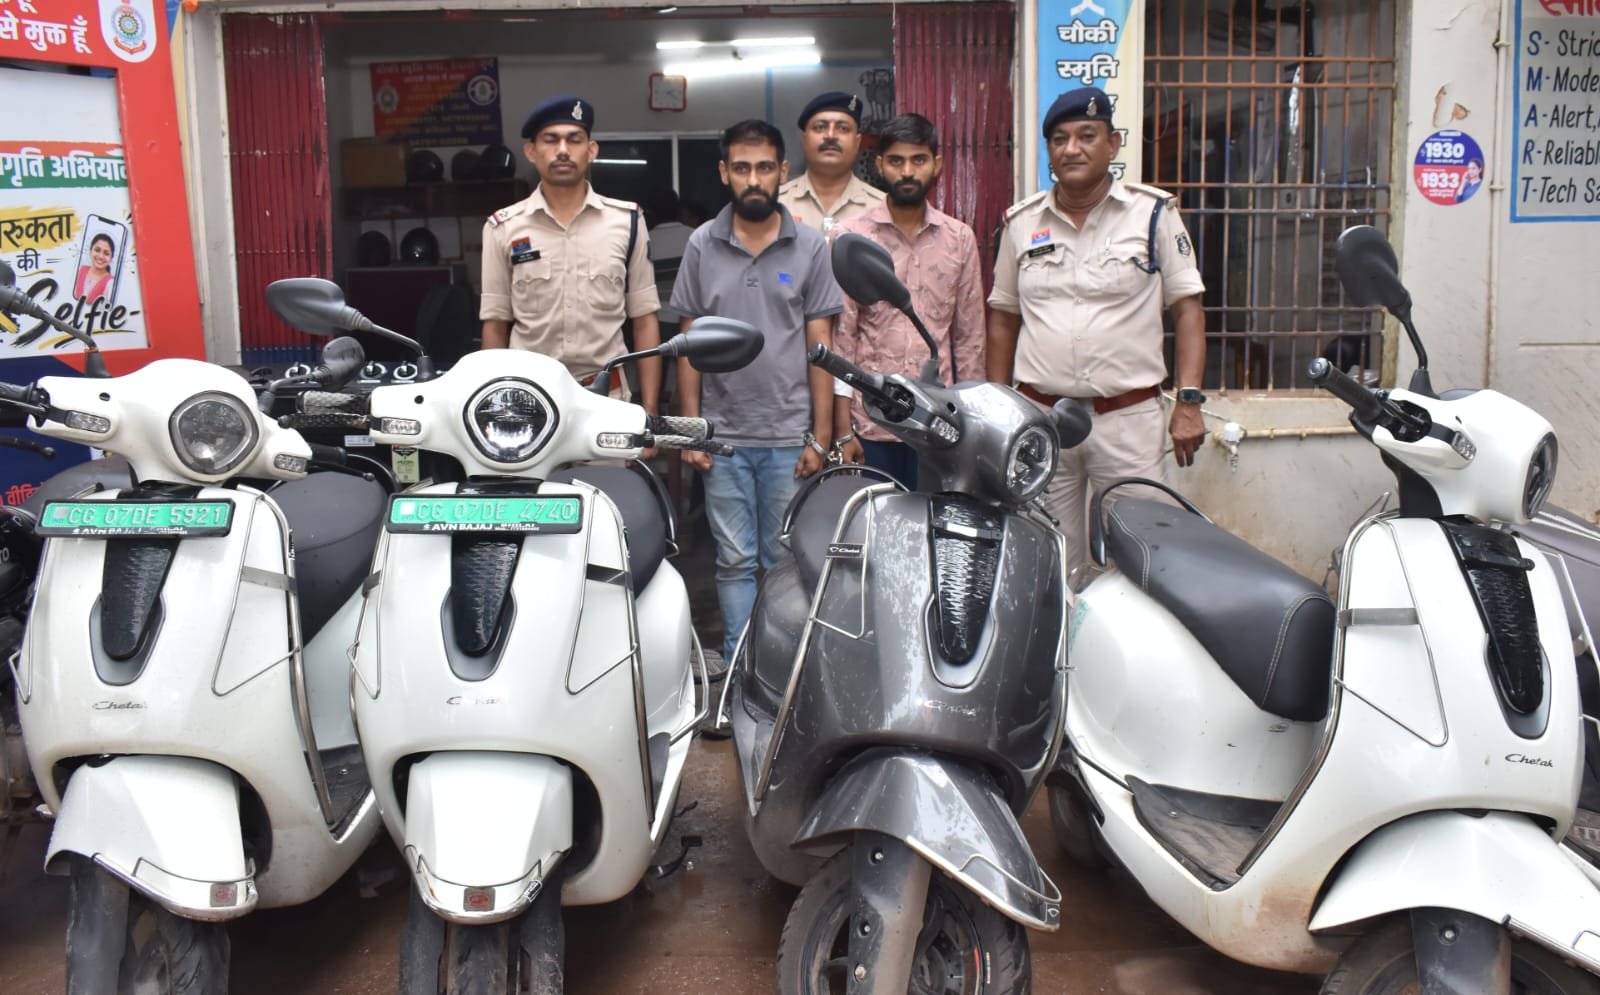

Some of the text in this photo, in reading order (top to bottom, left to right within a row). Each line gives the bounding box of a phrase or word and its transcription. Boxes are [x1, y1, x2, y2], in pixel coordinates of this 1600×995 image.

[0, 9, 93, 54] से मुक्त हूँ
[1057, 19, 1118, 43] चौकी
[1057, 53, 1119, 85] स्मृति
[1425, 142, 1465, 158] 1930
[0, 146, 44, 187] गृति
[1421, 172, 1459, 189] 1933
[0, 213, 74, 248] रुकता
[16, 247, 41, 272] की
[68, 506, 222, 524] CG 07DE 5921
[417, 502, 575, 520] CG 07DE 4740
[432, 523, 458, 531] AVN
[459, 523, 493, 531] BAJAJ
[92, 700, 148, 710] Cheta
[1504, 753, 1553, 768] Chetak
